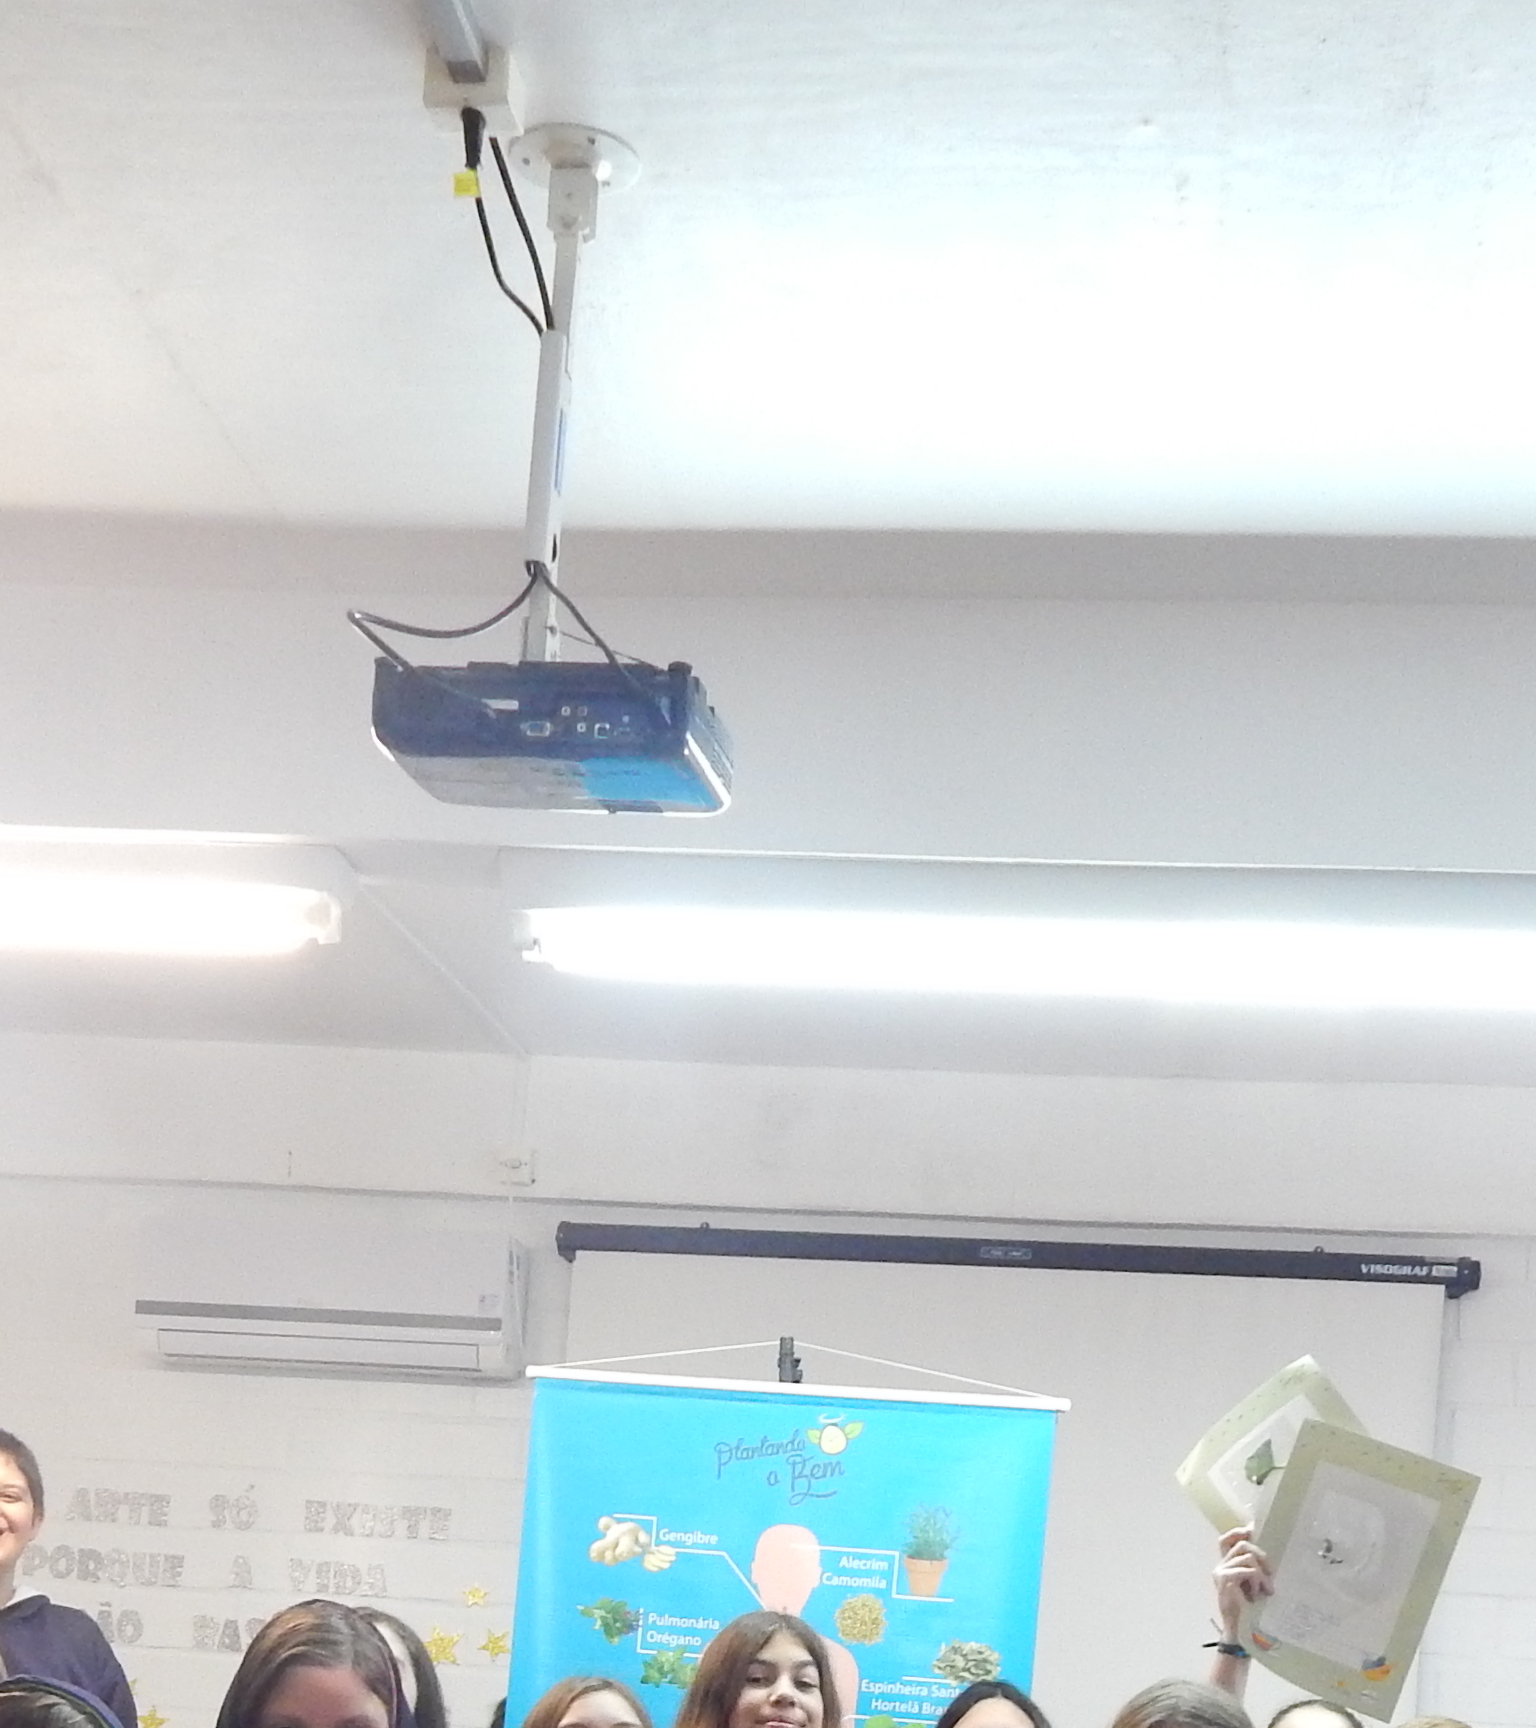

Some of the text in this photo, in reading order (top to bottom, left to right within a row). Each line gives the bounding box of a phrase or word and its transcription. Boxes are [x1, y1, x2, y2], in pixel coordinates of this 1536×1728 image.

[65, 1484, 452, 1541] ARTE SÓ EXISTE
[659, 1528, 719, 1545] Gengibre
[22, 1544, 185, 1588] PORQUE
[289, 1557, 389, 1598] VIDA
[839, 1555, 889, 1571] Alecrim
[822, 1572, 887, 1590] Camomila
[97, 1601, 144, 1644] ÃO
[648, 1612, 720, 1630] Pulmonária
[646, 1629, 702, 1647] Orégano
[860, 1678, 961, 1699] Espinheira Sant
